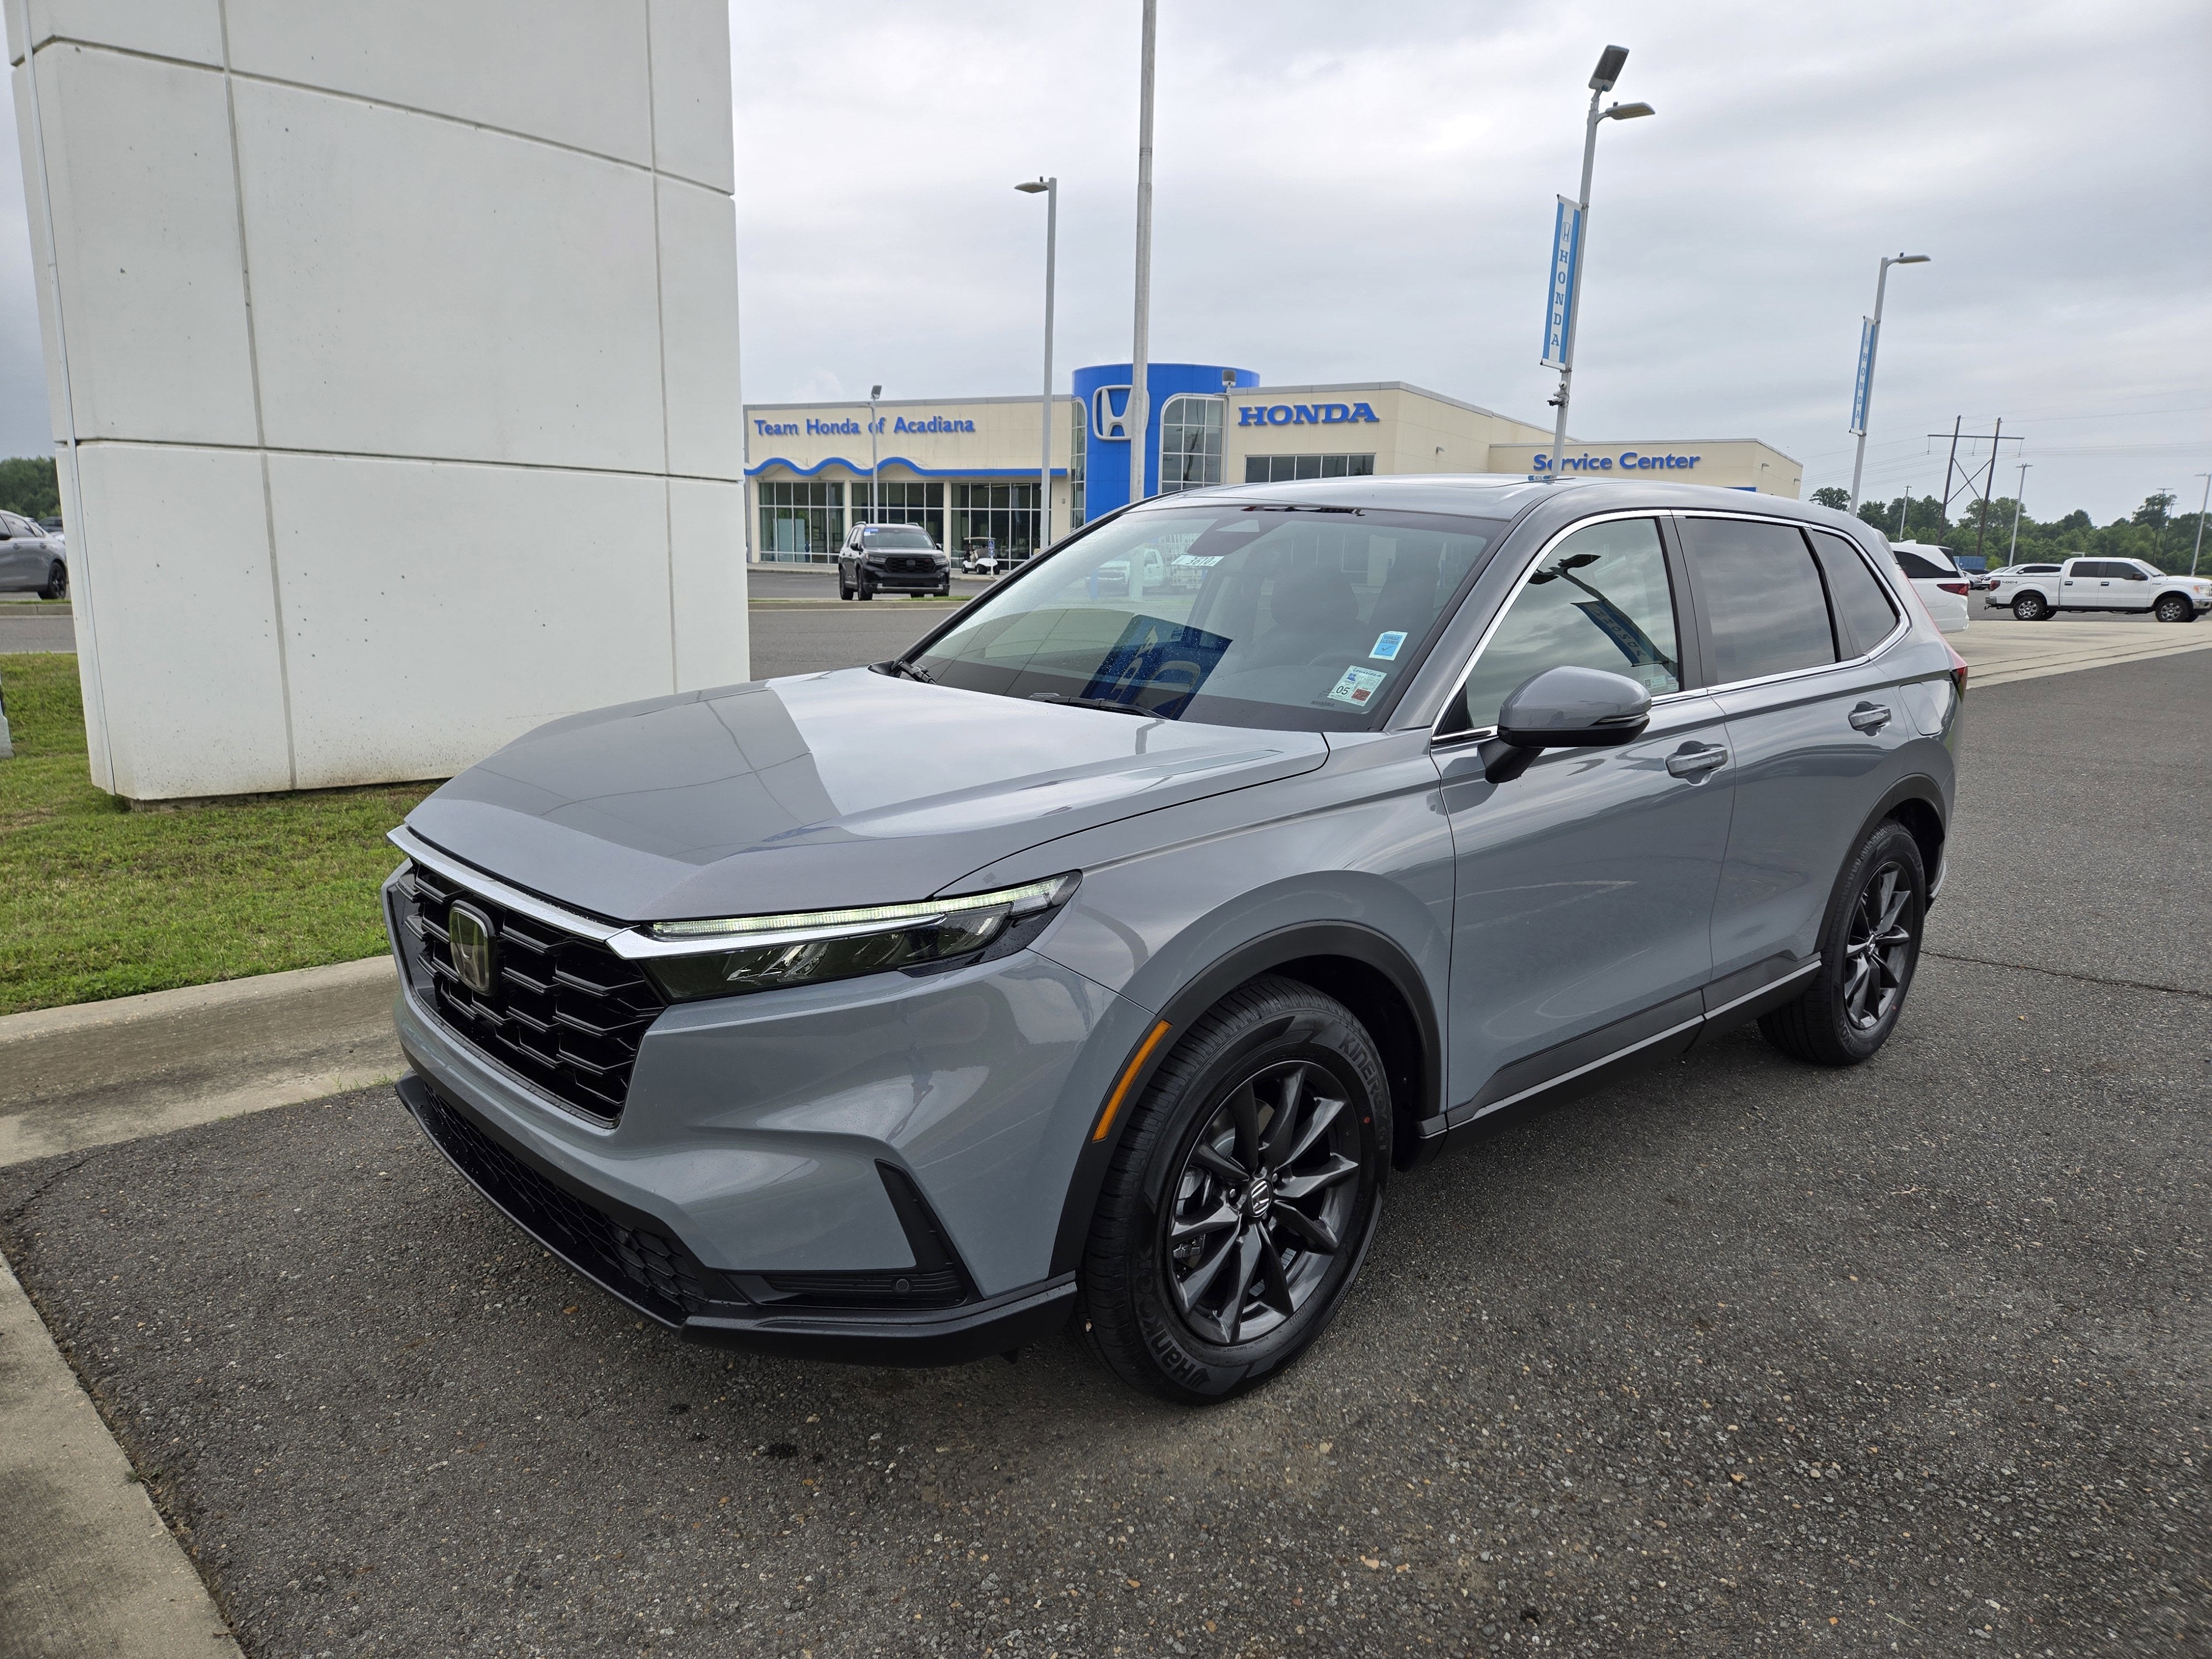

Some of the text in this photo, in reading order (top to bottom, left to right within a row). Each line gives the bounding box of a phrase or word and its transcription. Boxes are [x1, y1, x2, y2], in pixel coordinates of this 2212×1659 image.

[1551, 249, 1569, 346] HONDA
[1856, 352, 1867, 419] HONDA
[1238, 403, 1379, 426] HONDA
[754, 416, 975, 436] Team Honda of Acadiana
[1619, 452, 1701, 469] Center
[1336, 686, 1350, 695] 05
